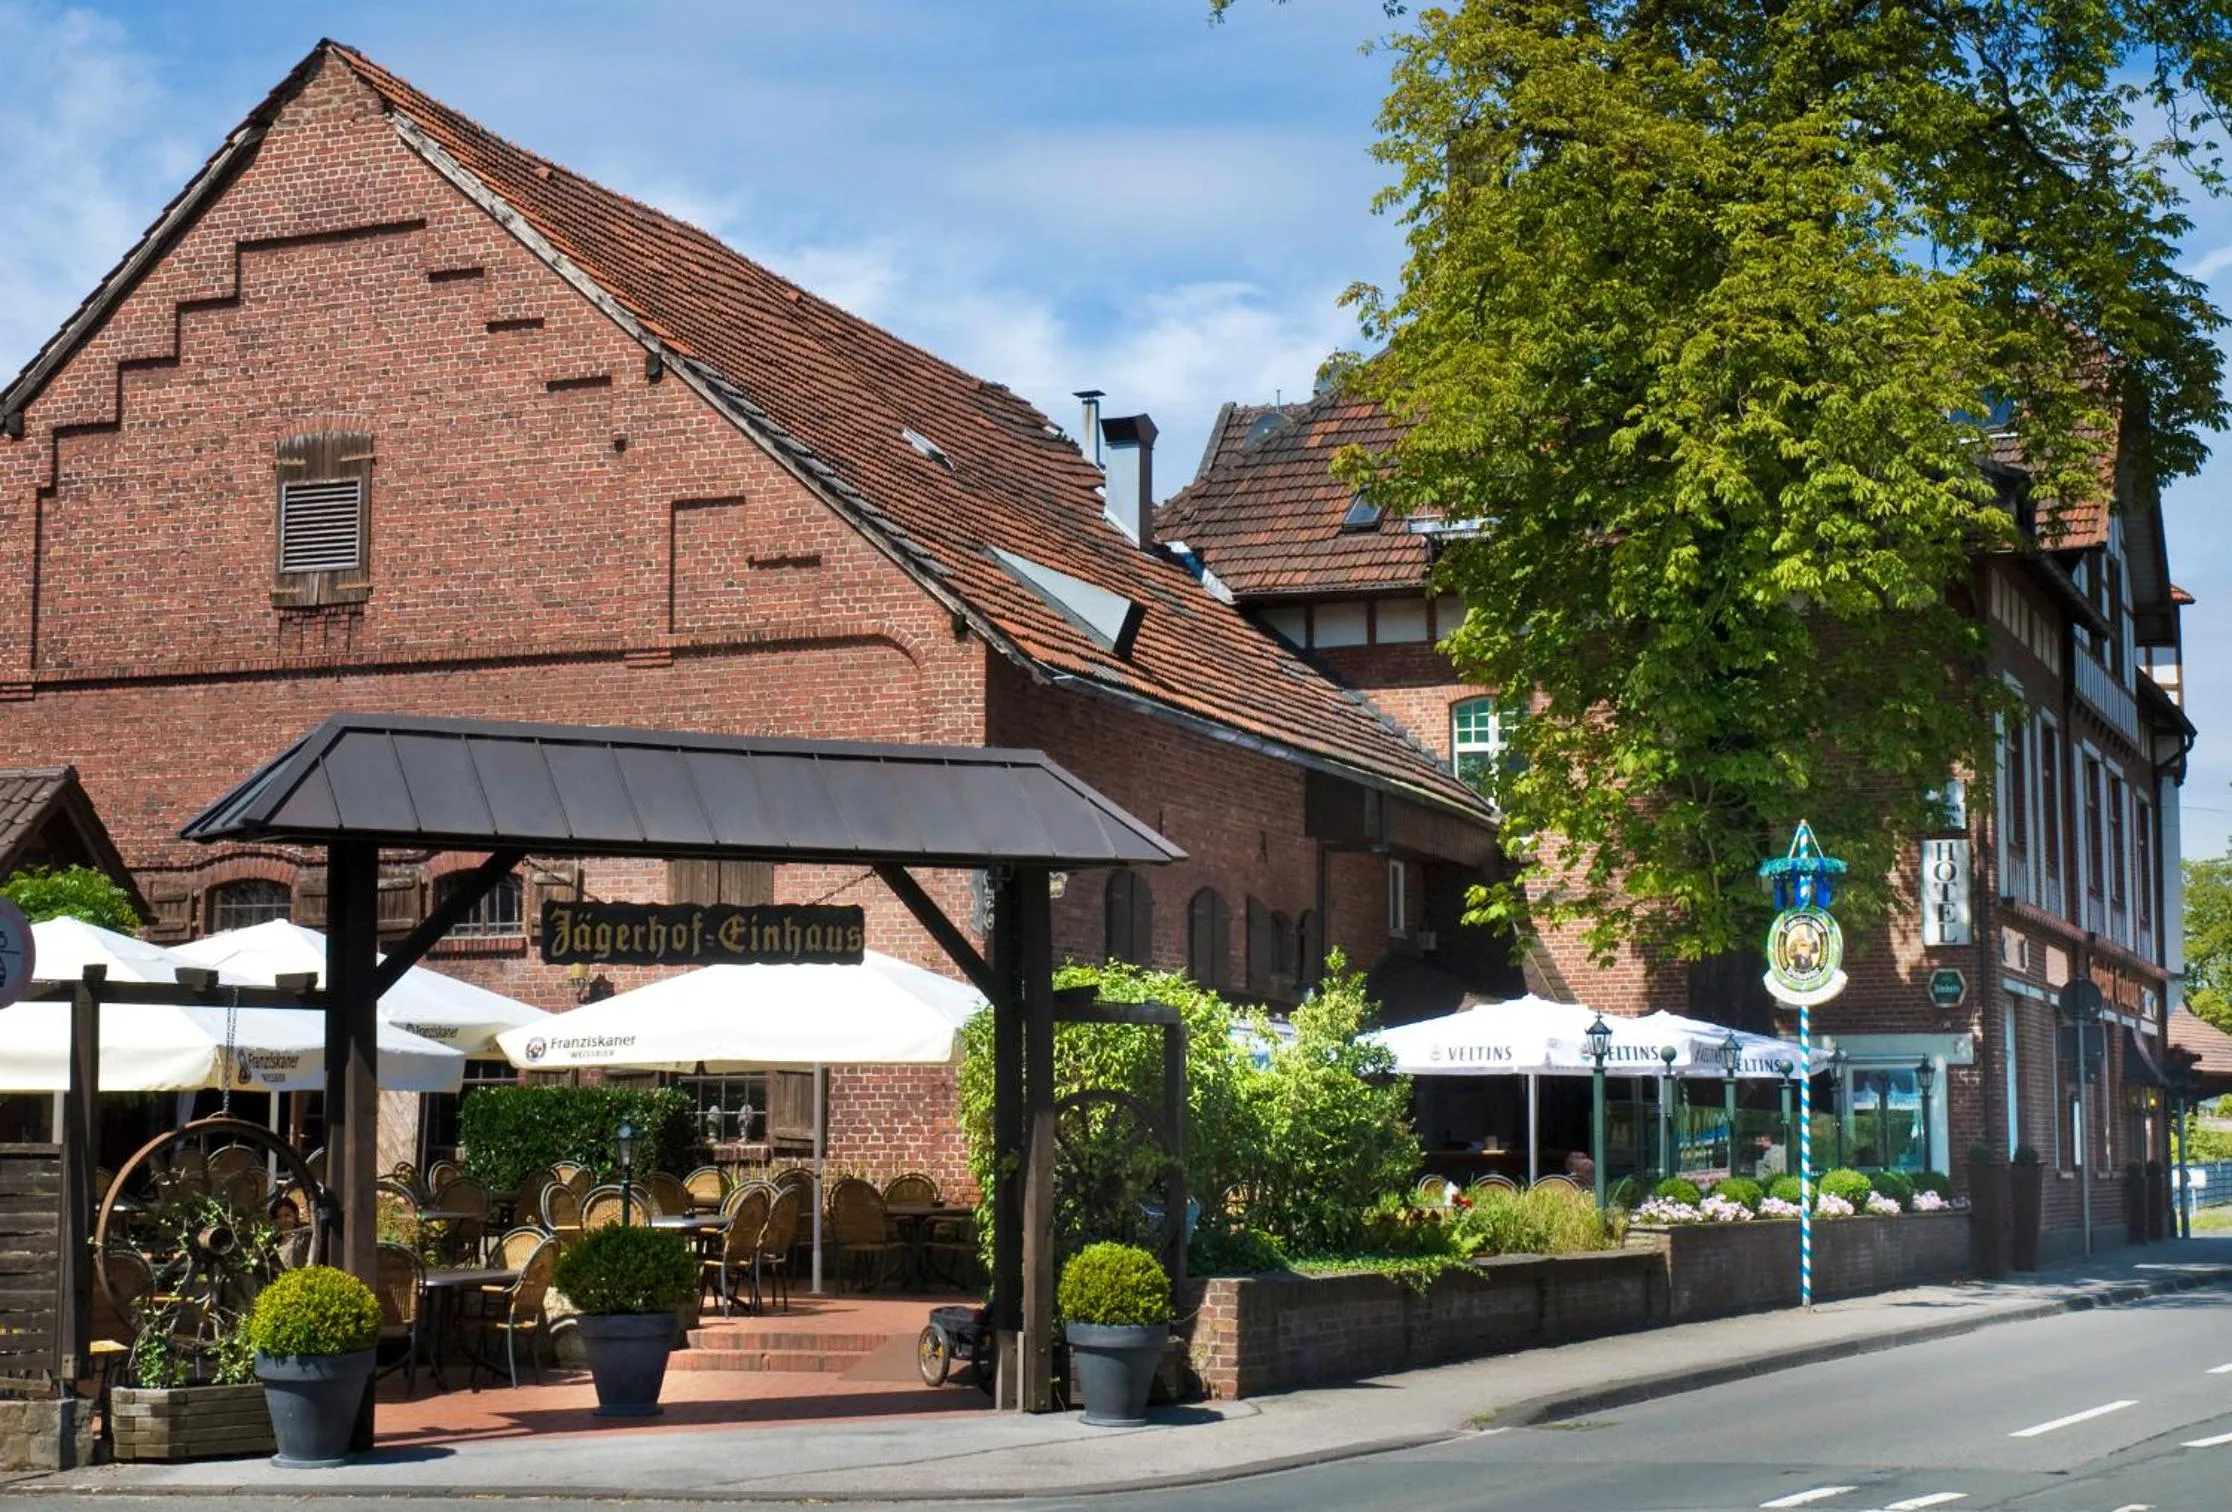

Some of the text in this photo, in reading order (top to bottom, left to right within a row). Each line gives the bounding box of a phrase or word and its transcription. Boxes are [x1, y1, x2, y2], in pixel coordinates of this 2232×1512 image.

[1933, 841, 1958, 943] HOTEL
[551, 909, 864, 959] Jägerhof-Einhaus
[550, 1035, 637, 1050] Franziskaner
[1448, 1045, 1513, 1061] VELTINS
[1606, 1045, 1659, 1061] ELTINS
[248, 1052, 300, 1071] Franziskaner
[1735, 1058, 1781, 1073] ELTINS
